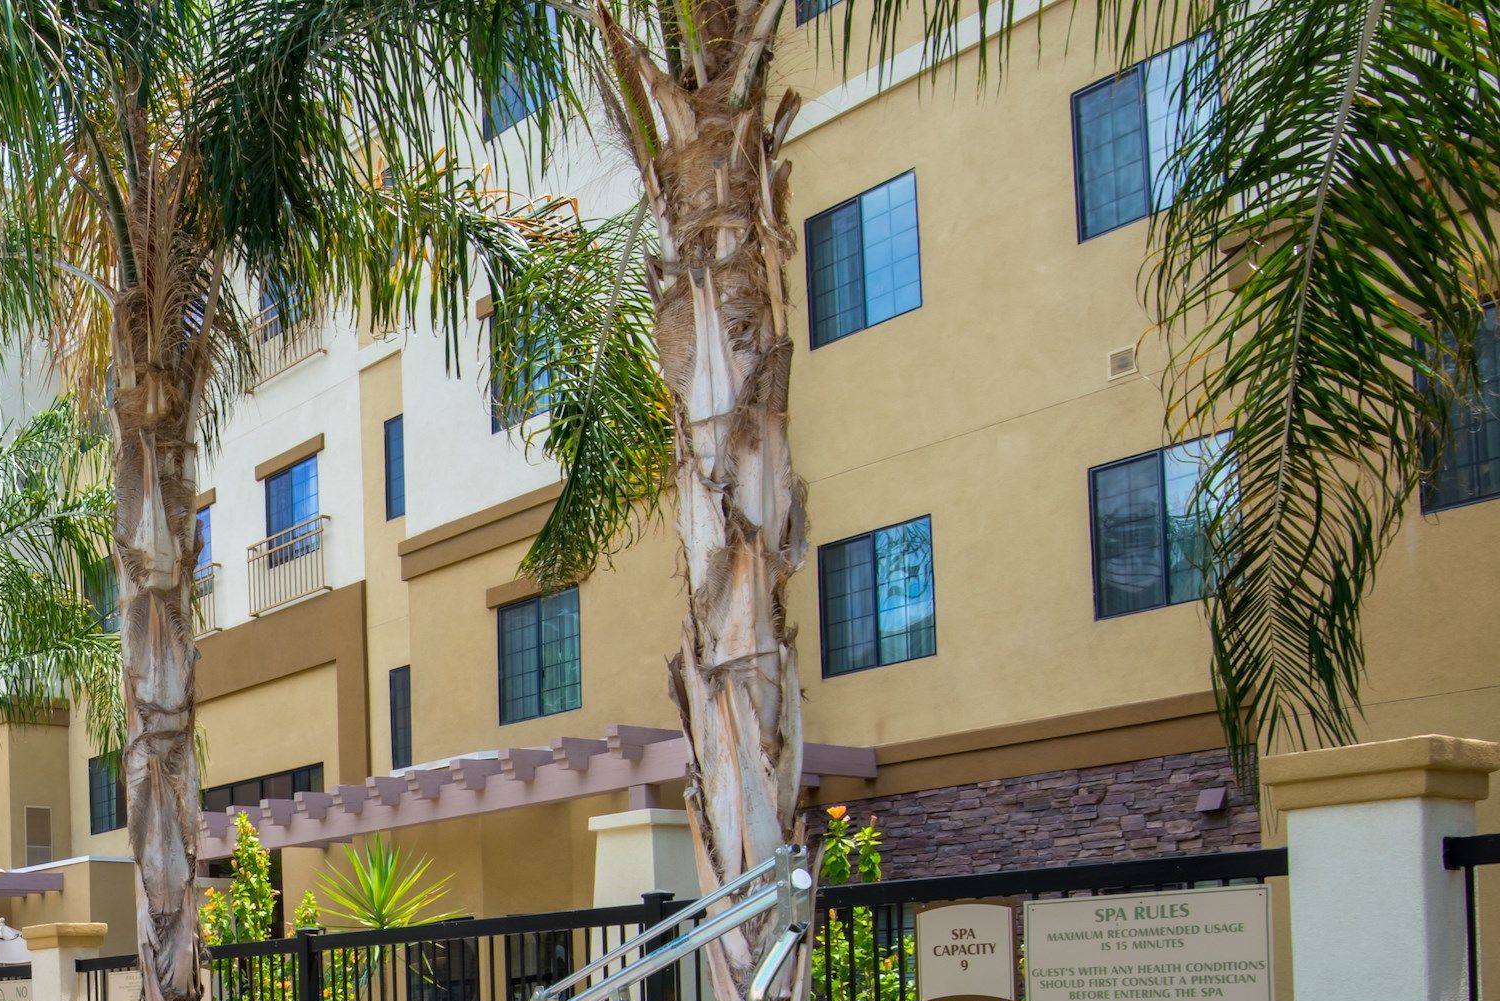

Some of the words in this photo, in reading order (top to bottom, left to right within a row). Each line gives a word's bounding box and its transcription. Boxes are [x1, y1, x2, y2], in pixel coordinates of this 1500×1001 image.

[1094, 907, 1127, 922] SPA
[1135, 903, 1190, 920] RULES
[952, 928, 976, 940] SPA
[1047, 930, 1103, 941] MAXIMUM
[1107, 925, 1200, 938] RECOMMENDED
[1205, 923, 1244, 933] USAGE
[933, 943, 996, 956] CAPACITY
[1101, 942, 1111, 950] IS
[1116, 941, 1127, 950] 15
[1132, 938, 1184, 949] MINUTES
[961, 960, 968, 971] 9
[1032, 968, 1075, 977] GUEST'S
[1078, 967, 1106, 976] WITH
[1111, 966, 1133, 974] ANY
[1138, 964, 1181, 973] HEALTH
[1186, 961, 1265, 972] CONDITIONS
[1040, 979, 1085, 989] SHOULD
[1089, 978, 1118, 987] FIRST
[1122, 976, 1174, 986] CONSULT
[1179, 976, 1186, 984] A
[1191, 974, 1256, 984] PHYSICIAN
[16, 986, 27, 998] NO
[1069, 990, 1109, 999] BEFORE
[1114, 989, 1170, 998] ENTERING
[1175, 988, 1196, 997] THE
[1201, 988, 1223, 997] SPA
